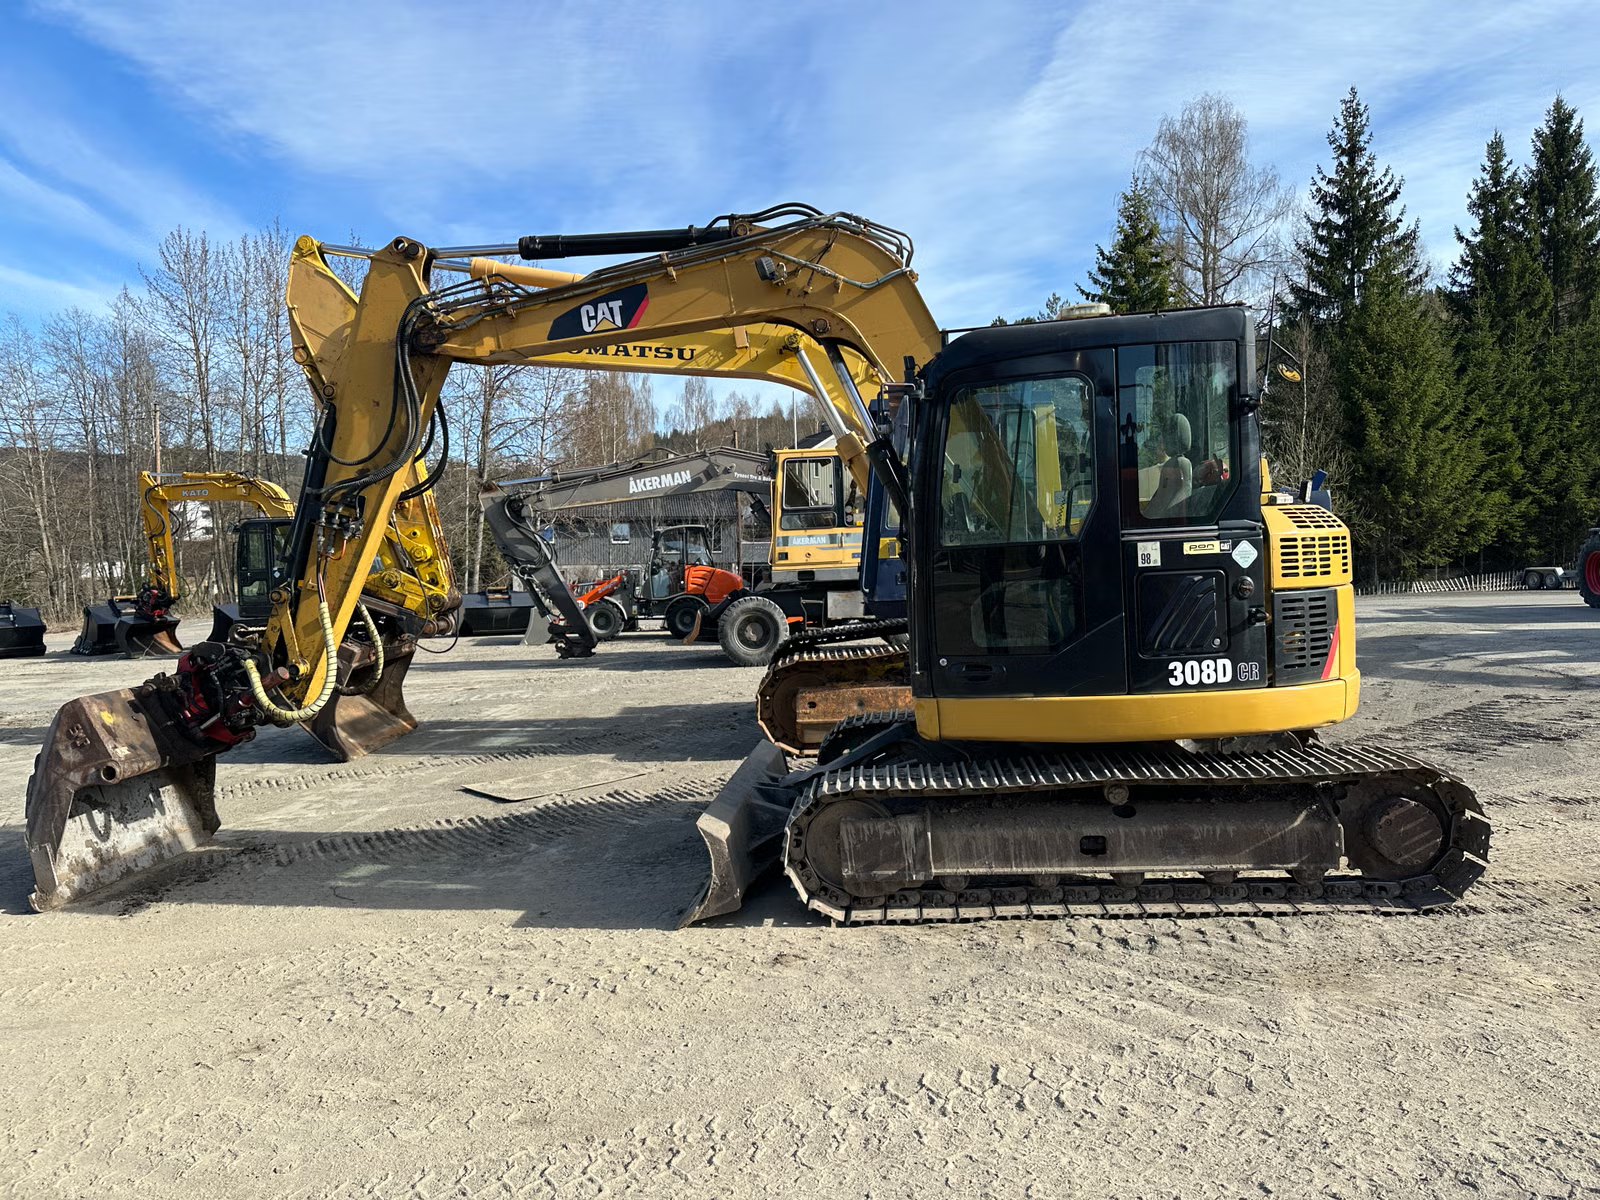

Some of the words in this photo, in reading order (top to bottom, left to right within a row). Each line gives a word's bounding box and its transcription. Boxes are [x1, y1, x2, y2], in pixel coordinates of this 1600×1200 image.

[580, 300, 623, 333] CAT
[567, 344, 696, 361] MATSU
[629, 470, 692, 494] ÅKERMAN
[1140, 552, 1151, 565] 98
[1168, 658, 1232, 686] 308D
[1237, 662, 1260, 682] CR
